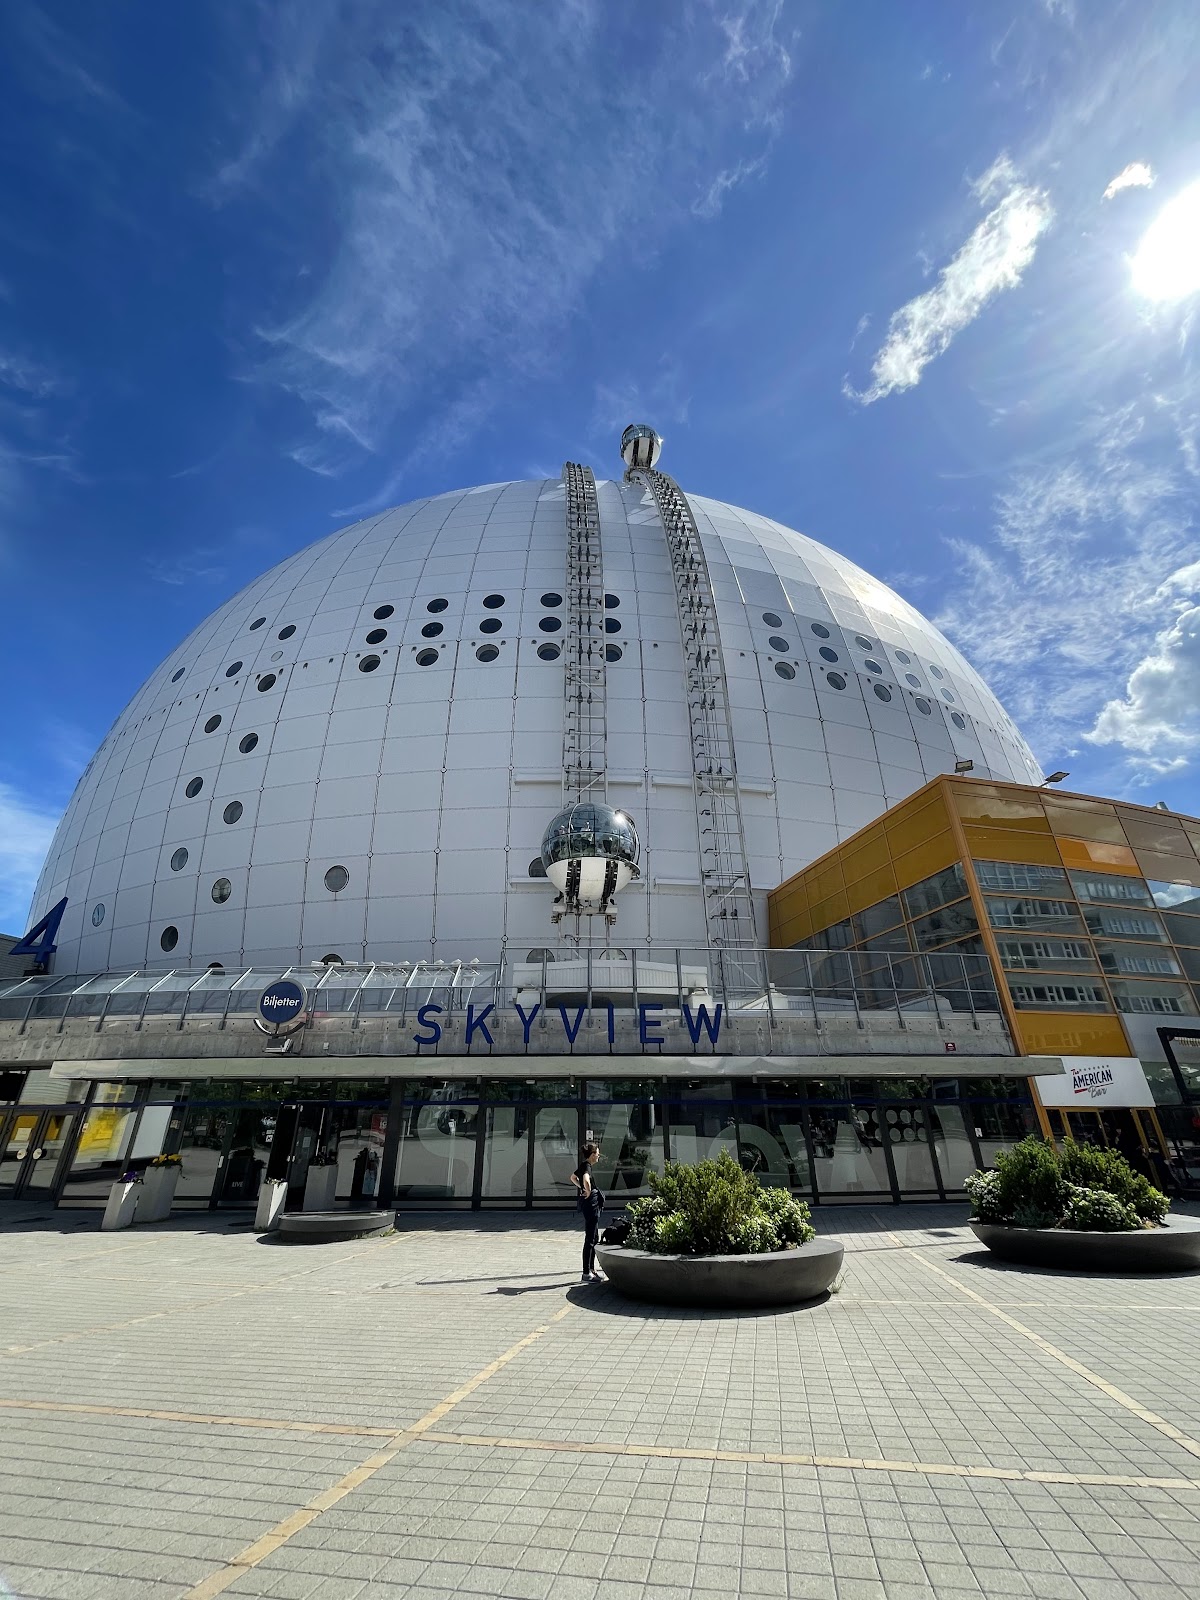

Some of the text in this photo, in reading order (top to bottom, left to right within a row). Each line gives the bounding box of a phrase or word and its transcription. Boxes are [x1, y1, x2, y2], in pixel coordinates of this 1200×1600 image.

[8, 896, 69, 963] 4
[263, 994, 300, 1009] Biljetter
[413, 1003, 723, 1045] SKYVIEW
[1073, 1069, 1113, 1089] AMERICAN
[1088, 1085, 1107, 1098] Bar
